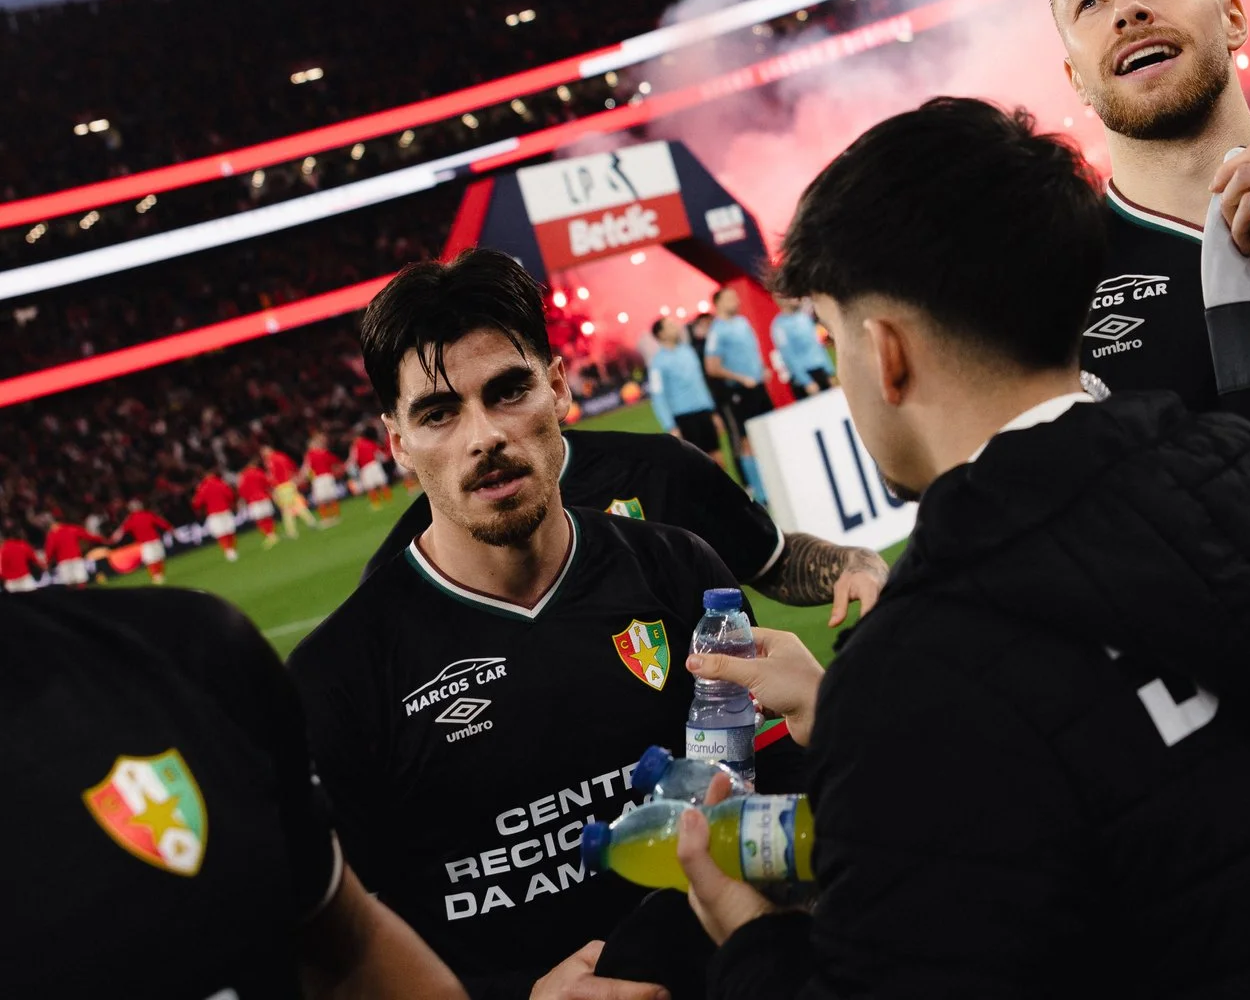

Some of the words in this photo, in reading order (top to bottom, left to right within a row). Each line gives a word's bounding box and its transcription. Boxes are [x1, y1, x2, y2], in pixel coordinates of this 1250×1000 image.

[568, 203, 661, 257] Betclic
[1089, 292, 1125, 310] COS
[1133, 283, 1168, 301] CAR
[1092, 339, 1143, 359] umbro
[405, 678, 470, 717] MARCOS
[475, 664, 508, 685] CAR
[446, 719, 494, 743] umbro
[686, 741, 726, 755] aramulo
[444, 885, 516, 921] DA
